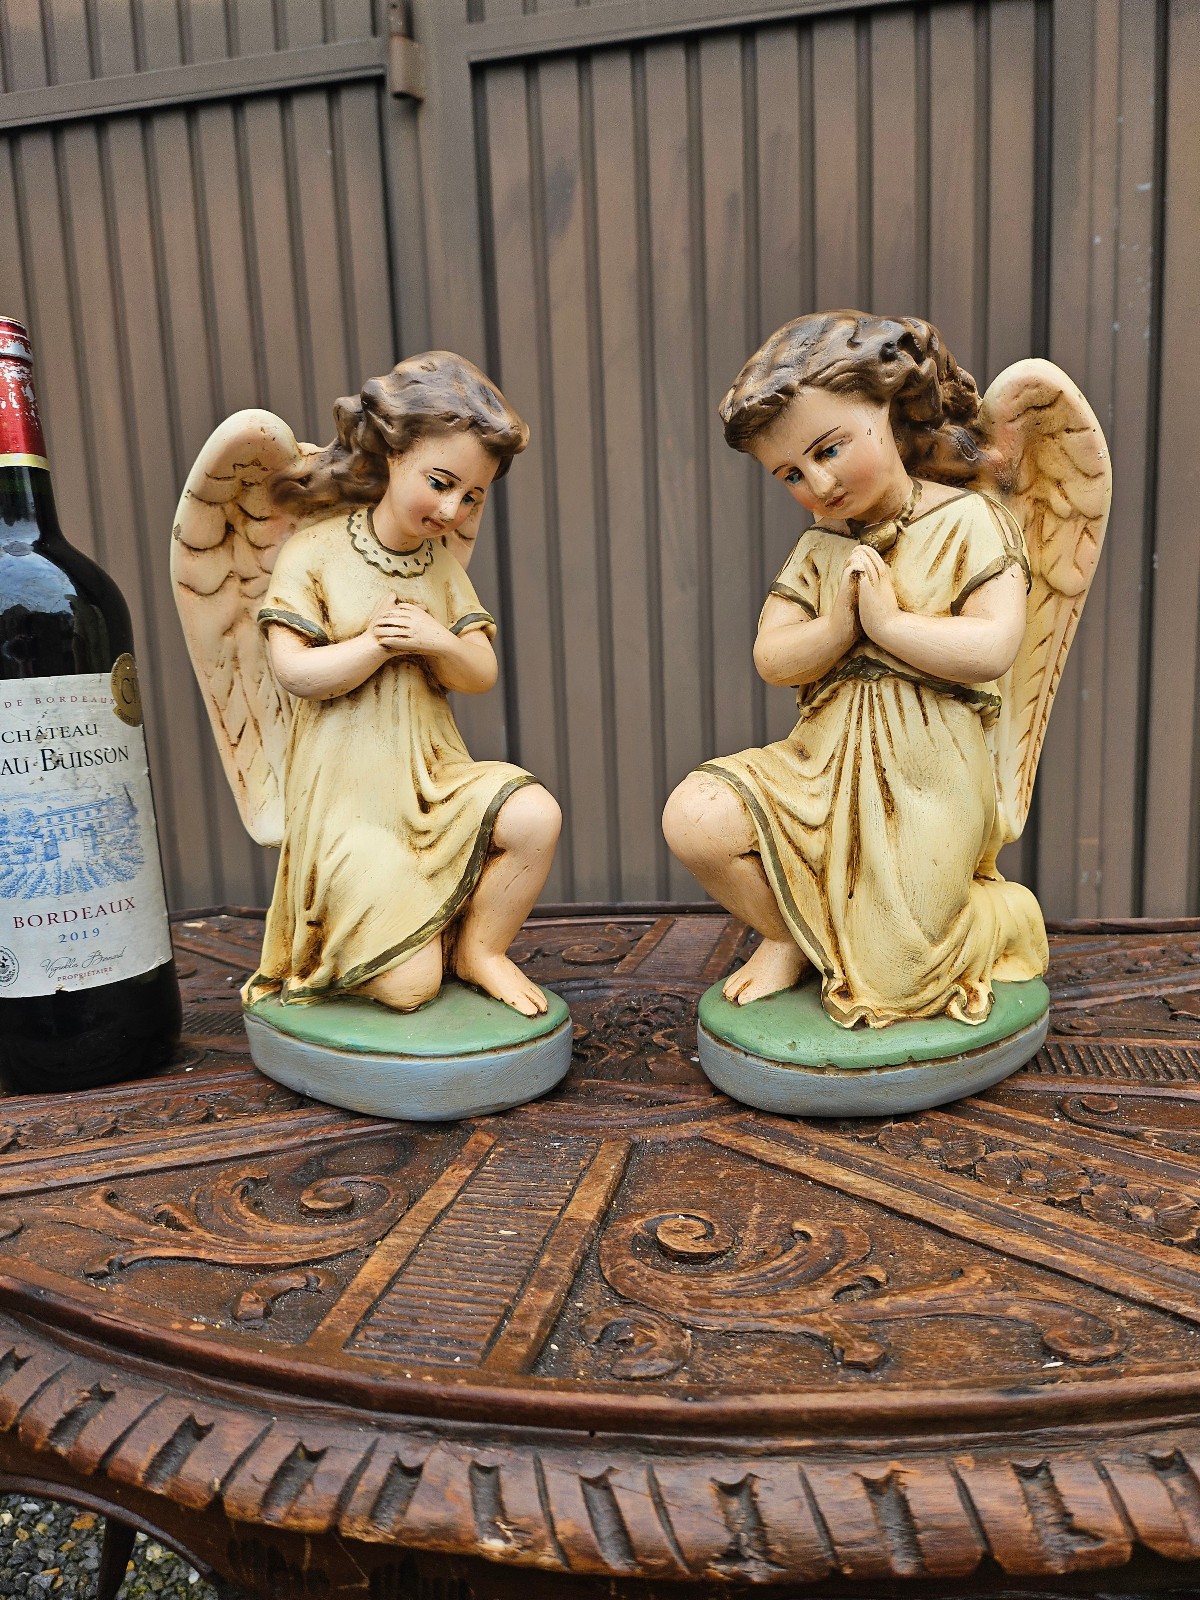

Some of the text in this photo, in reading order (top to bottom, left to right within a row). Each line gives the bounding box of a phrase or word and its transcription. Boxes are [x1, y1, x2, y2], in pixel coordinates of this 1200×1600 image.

[4, 695, 115, 709] DE BORDEAUX
[1, 723, 98, 744] CHÂTEAU
[13, 896, 136, 929] BORDEAUX
[58, 927, 100, 944] 2019
